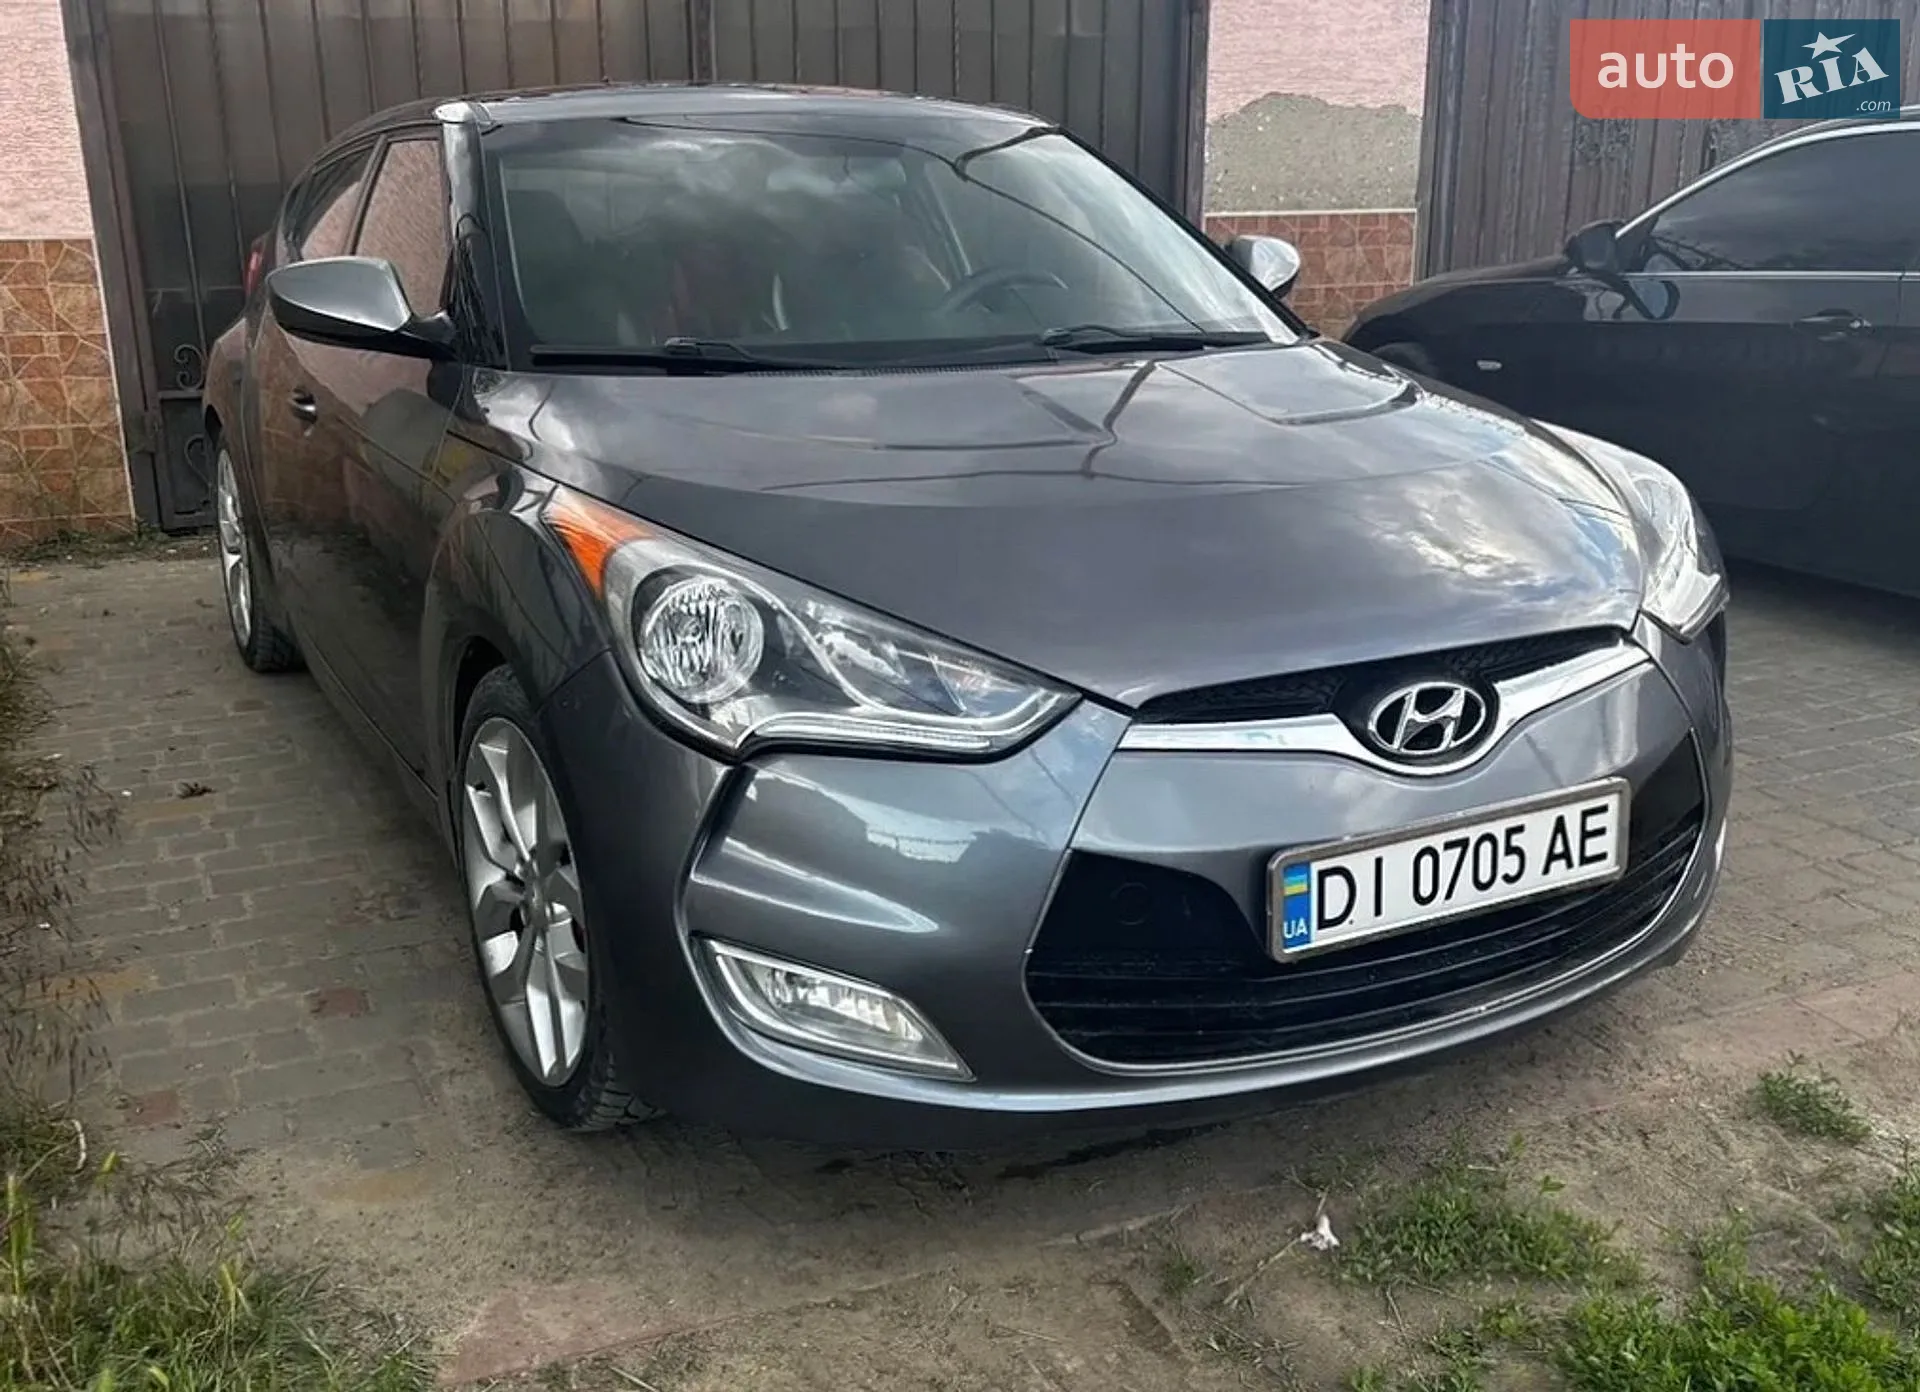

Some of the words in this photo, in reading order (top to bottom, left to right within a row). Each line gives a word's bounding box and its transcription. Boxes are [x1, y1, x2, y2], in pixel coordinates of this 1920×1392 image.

[1316, 856, 1384, 931] DI
[1412, 824, 1526, 906] 0705
[1541, 804, 1609, 876] AE
[1283, 918, 1309, 939] UA
